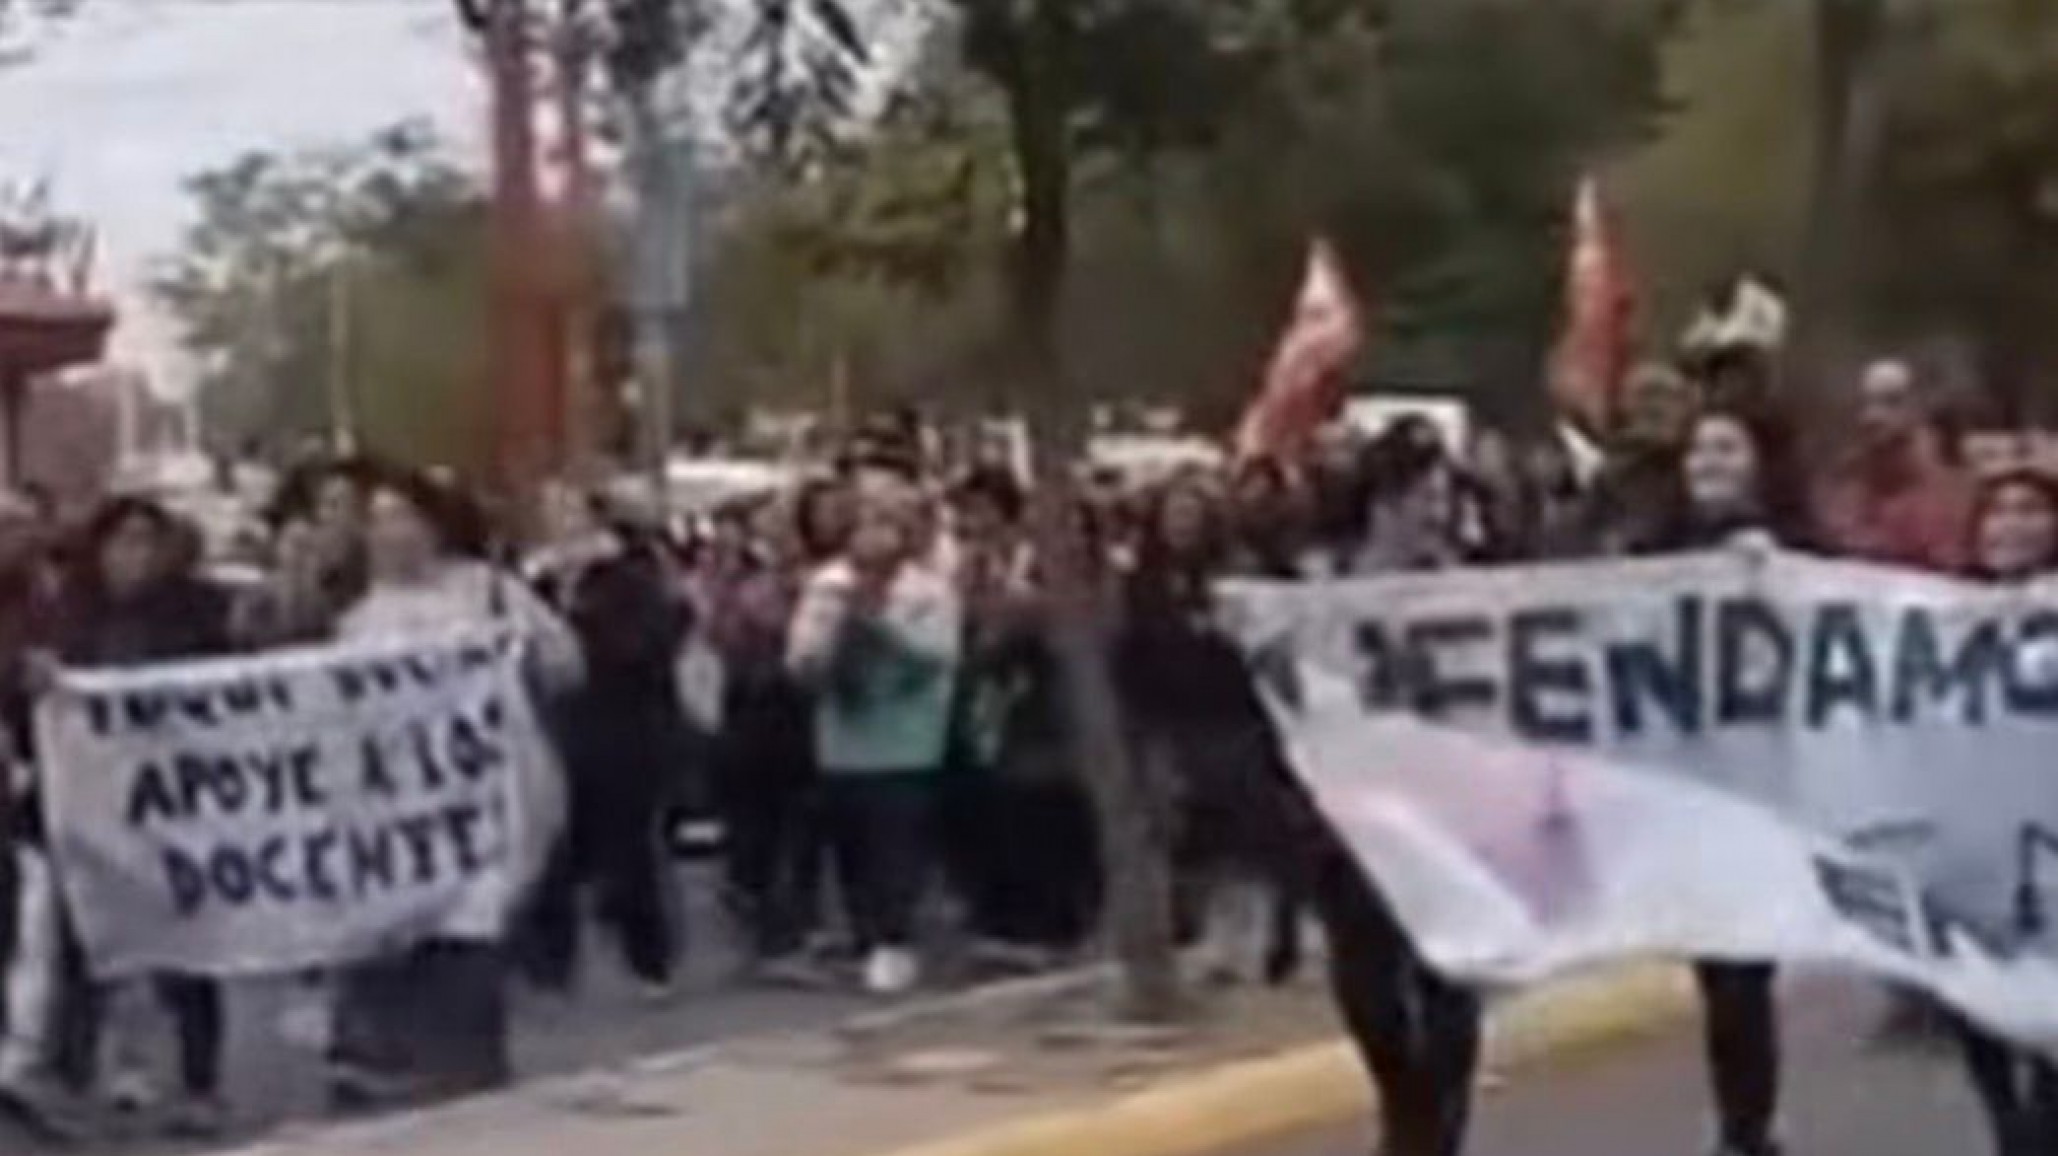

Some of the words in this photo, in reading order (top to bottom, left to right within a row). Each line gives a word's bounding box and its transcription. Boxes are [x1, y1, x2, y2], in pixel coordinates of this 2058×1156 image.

[1250, 594, 2058, 744] FENDAMO
[127, 744, 322, 826] APOYE
[162, 803, 506, 917] DOCENTE
